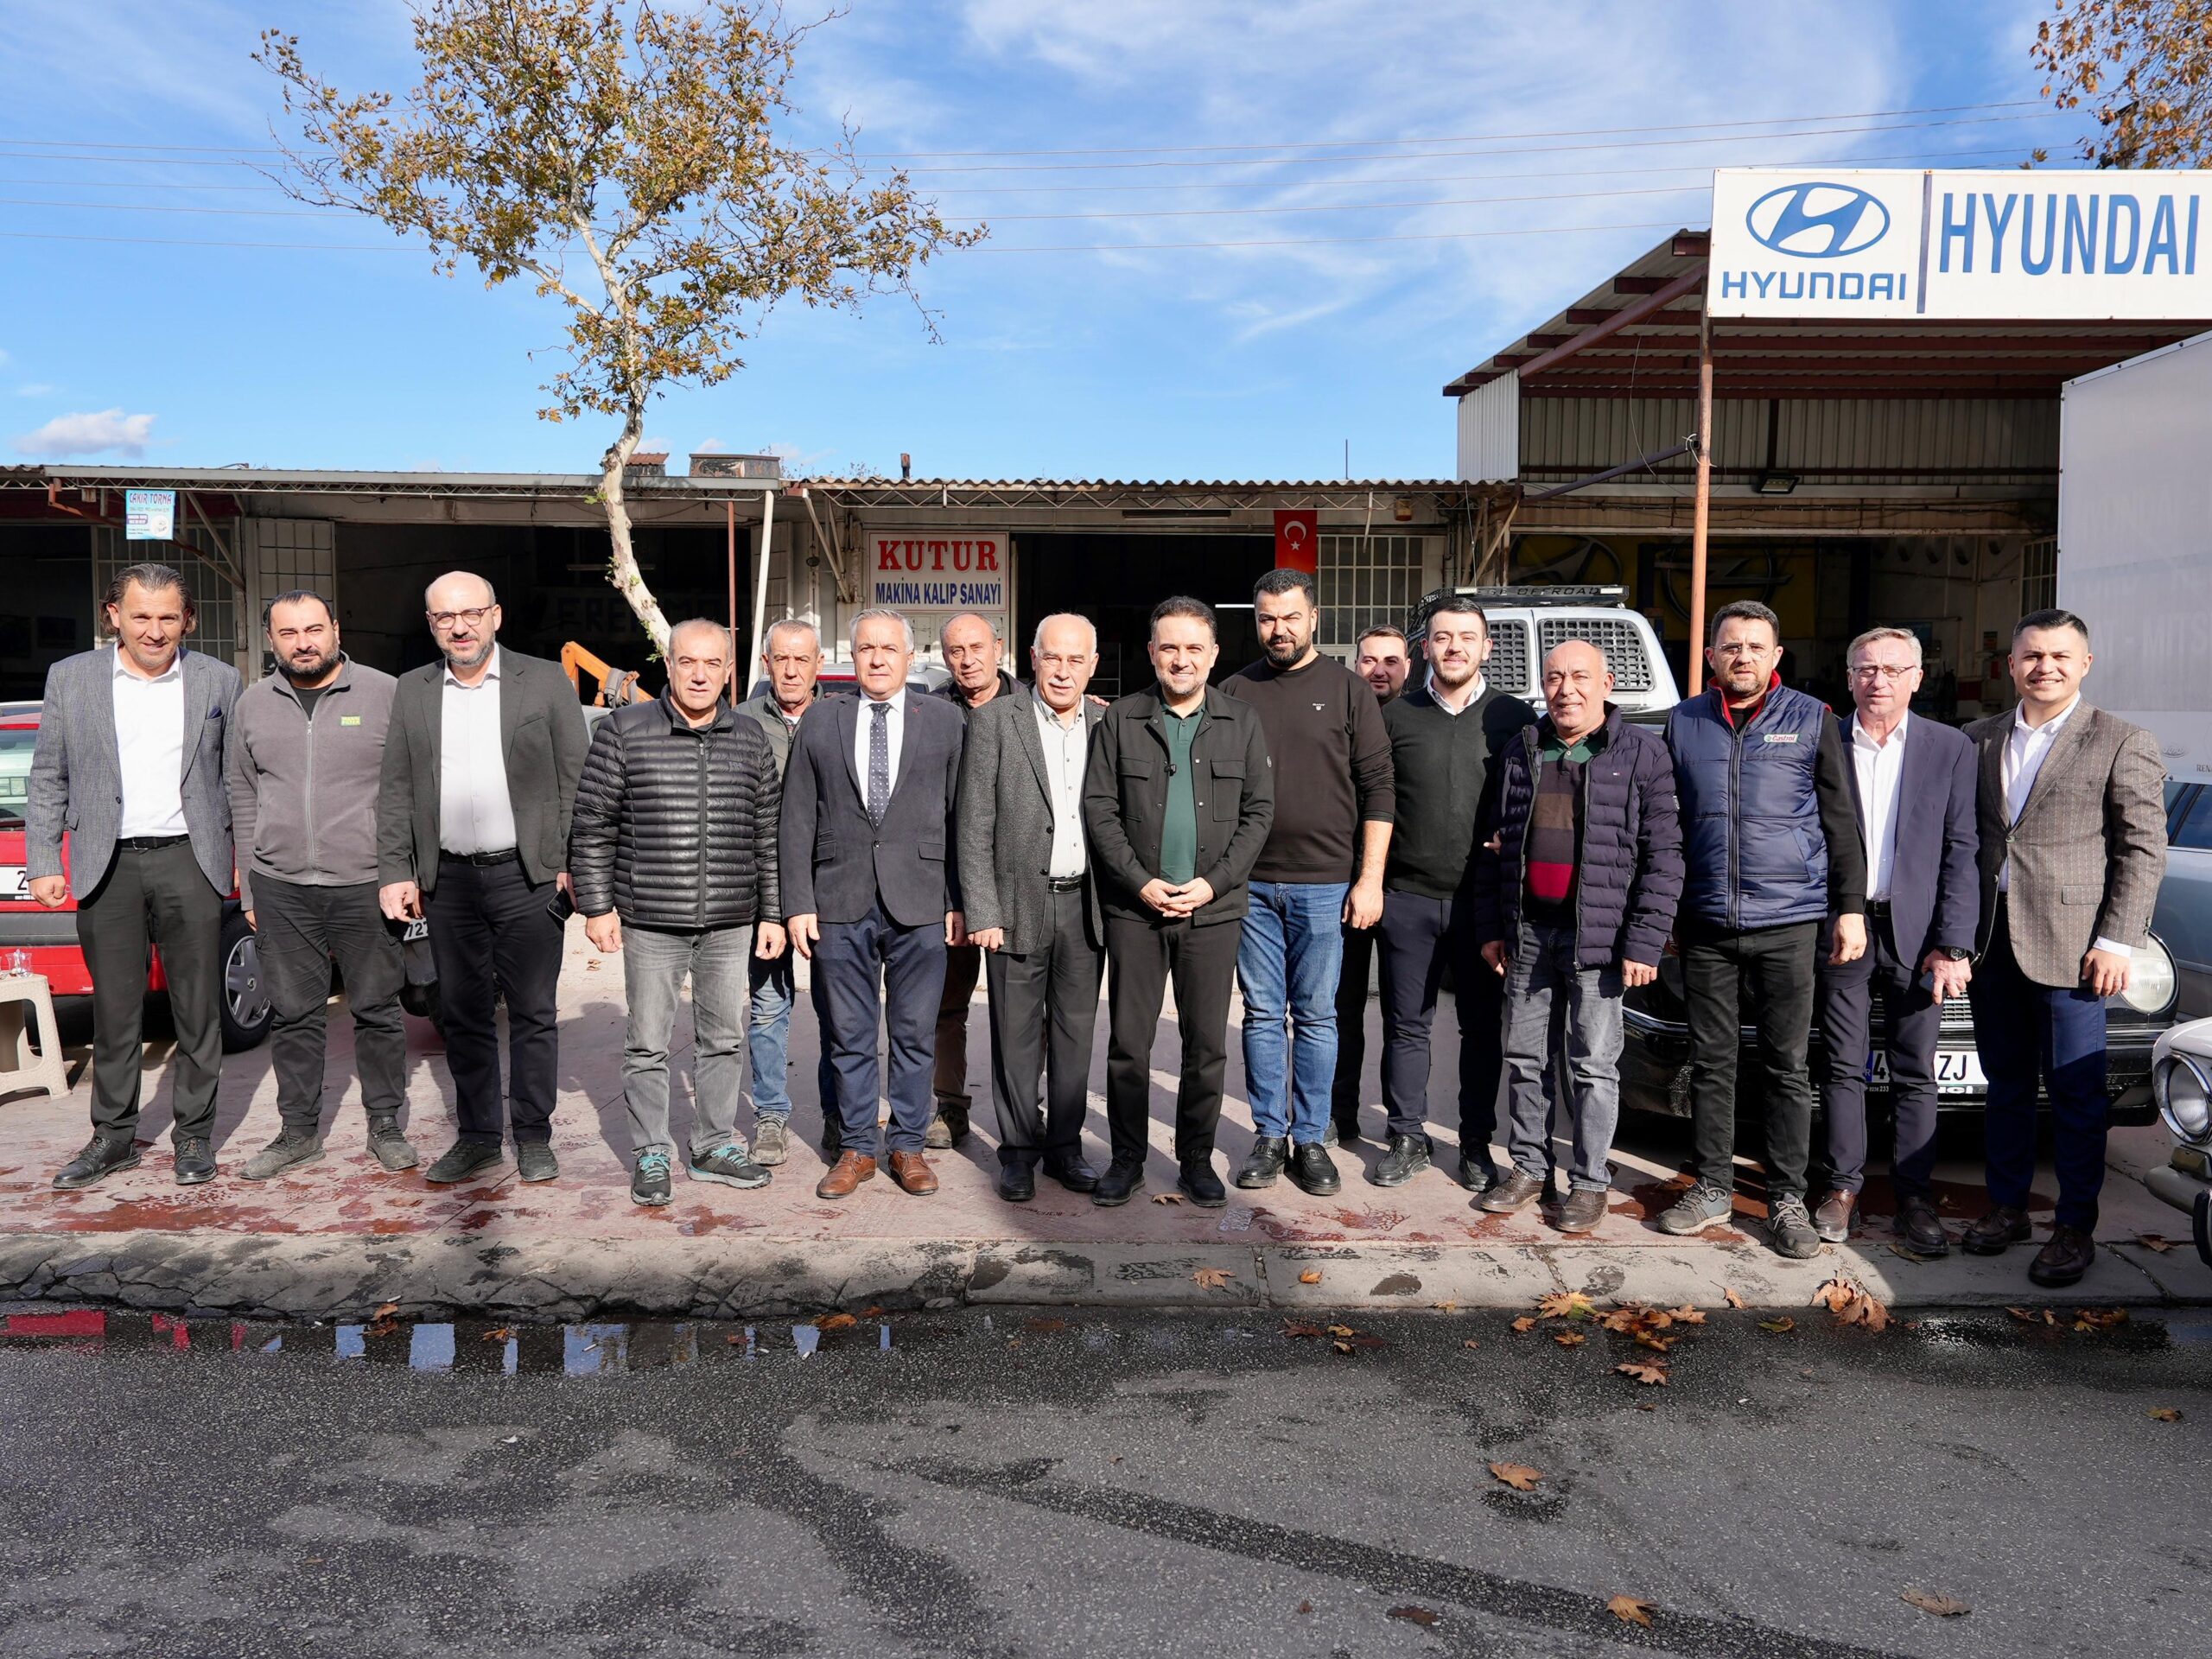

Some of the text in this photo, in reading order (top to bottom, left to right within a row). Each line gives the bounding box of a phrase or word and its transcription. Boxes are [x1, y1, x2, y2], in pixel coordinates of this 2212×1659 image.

[1939, 193, 2200, 276] HYUNDAI
[1722, 271, 1906, 300] HYUNDAI
[149, 493, 172, 505] TORNA
[877, 540, 999, 571] KUTUR
[875, 577, 1001, 605] MAKİNA KALIP SANAYİ
[1517, 587, 1599, 596] OFFROAD
[2196, 764, 2212, 772] REN
[1873, 1053, 1887, 1080] 4
